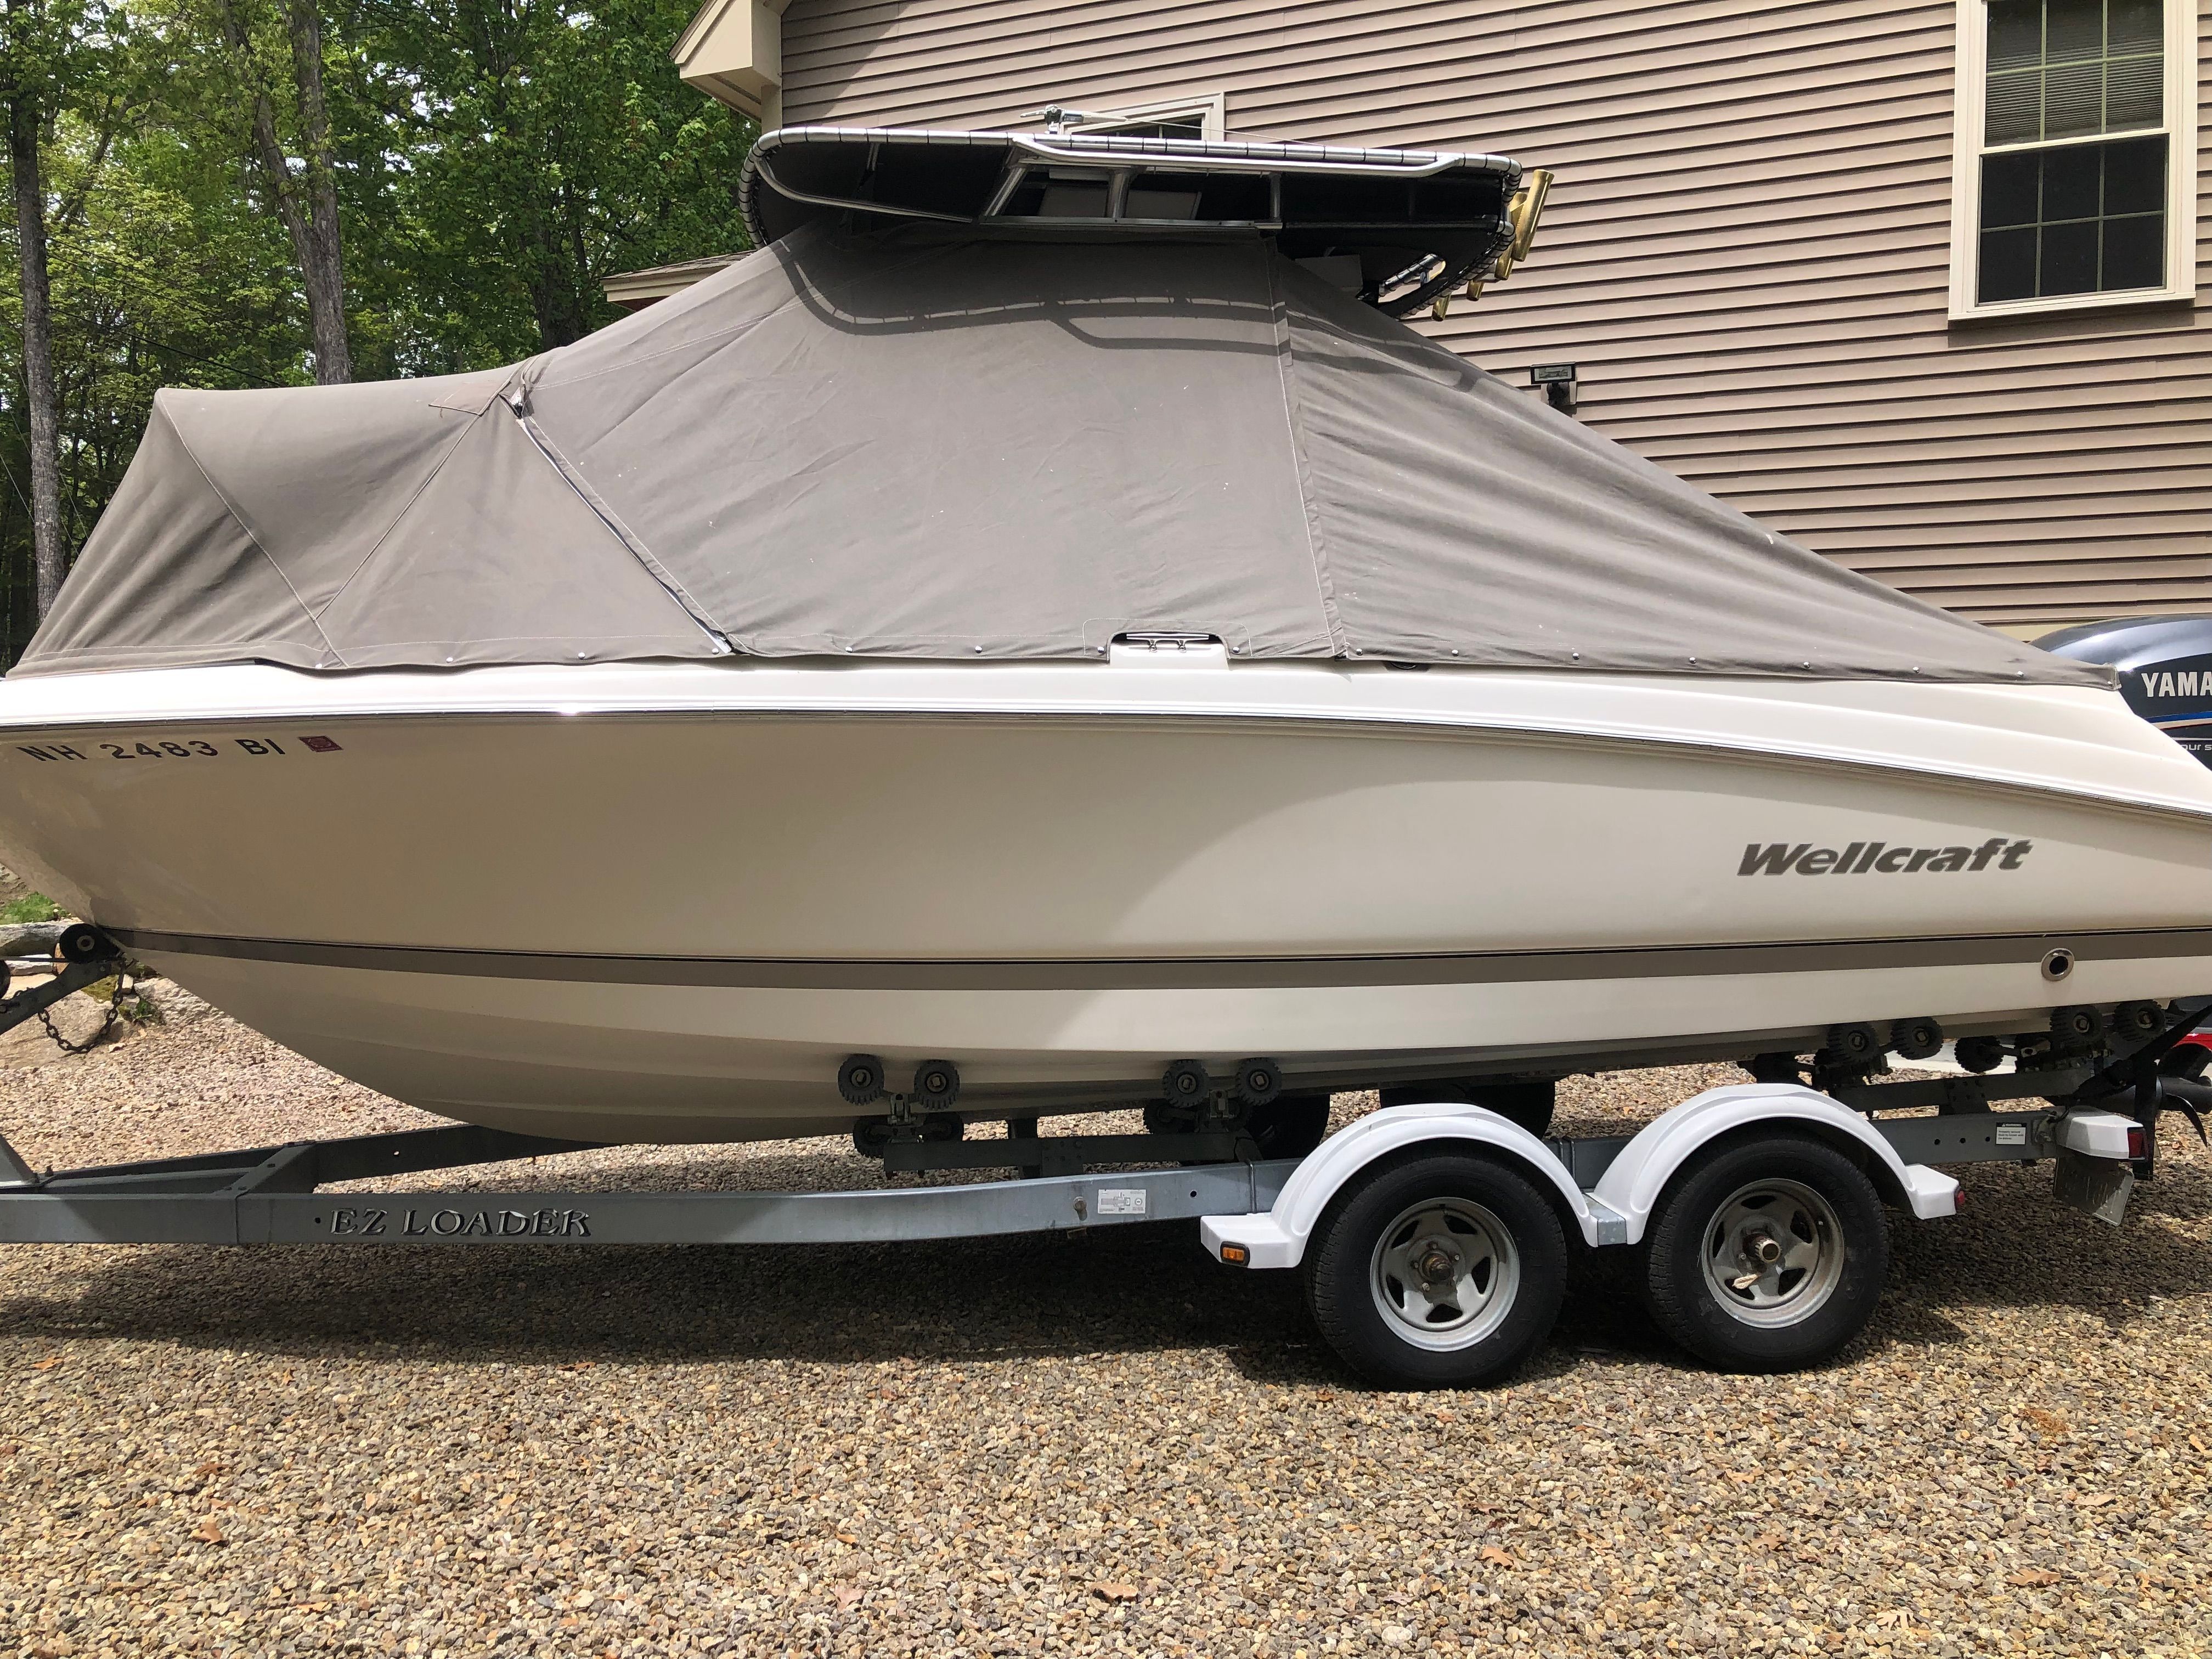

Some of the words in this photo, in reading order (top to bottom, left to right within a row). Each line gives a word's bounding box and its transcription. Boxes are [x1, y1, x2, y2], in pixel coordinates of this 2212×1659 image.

[17, 744, 88, 761] NH
[100, 740, 219, 759] 2483
[234, 738, 286, 755] BI
[1736, 837, 2034, 876] Wellcraft
[330, 1208, 387, 1235] EZ
[400, 1209, 592, 1237] LOADER
